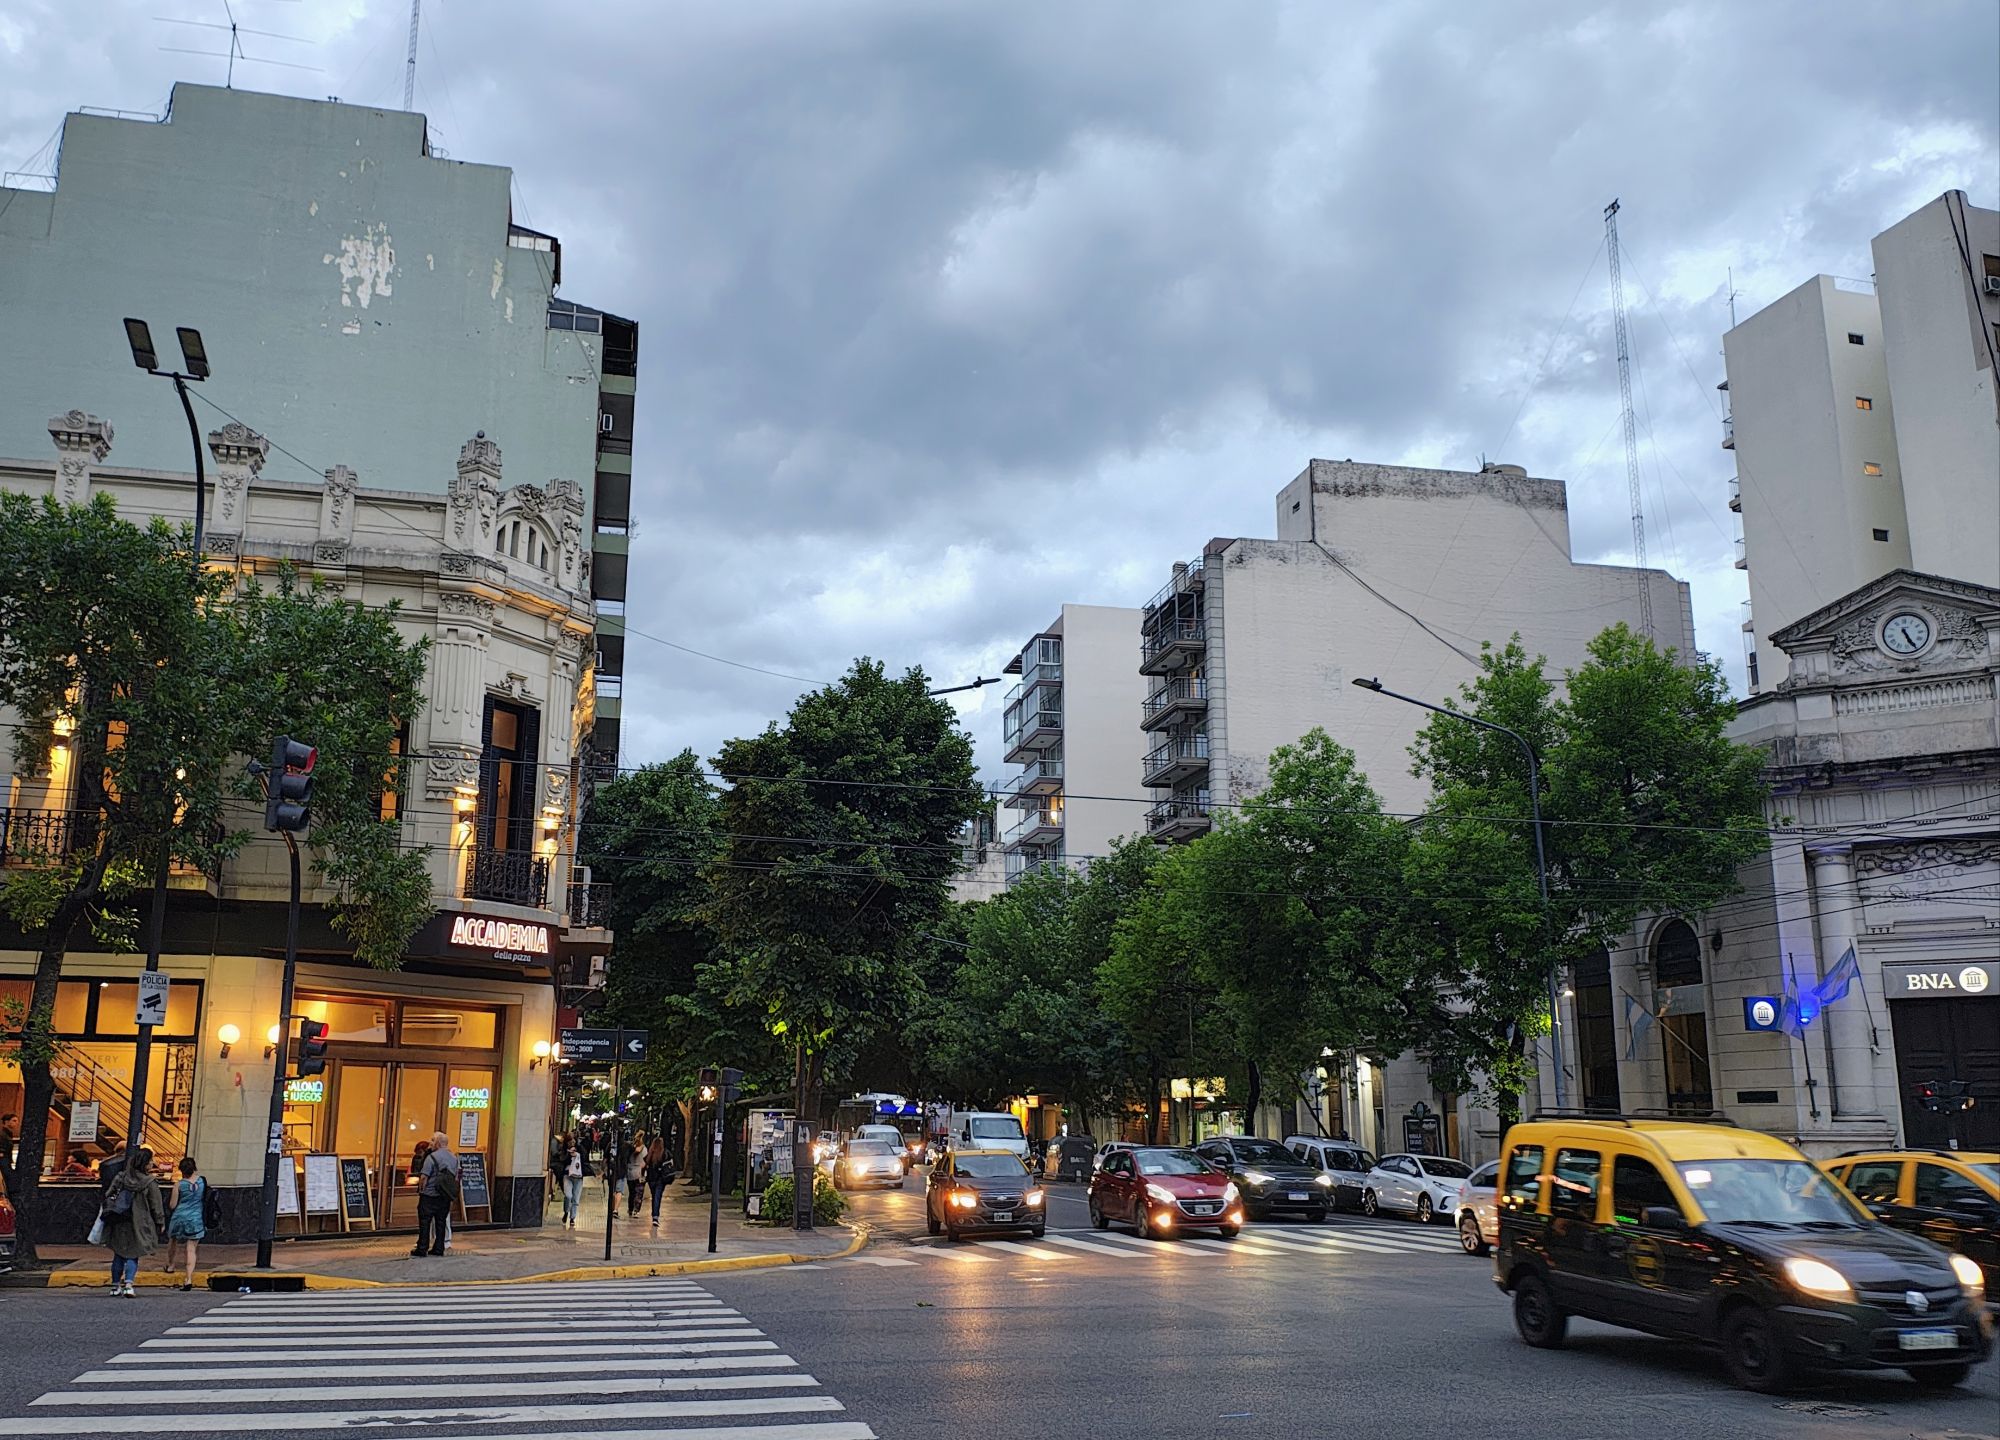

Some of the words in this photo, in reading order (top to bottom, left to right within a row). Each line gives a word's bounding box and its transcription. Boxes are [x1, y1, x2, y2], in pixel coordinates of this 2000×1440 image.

[1903, 867, 1964, 881] BANCO
[1938, 879, 1952, 887] LA
[451, 917, 548, 953] ACCADEMIA
[494, 951, 512, 960] della
[512, 954, 531, 962] pizza
[1906, 973, 1956, 990] BNA
[562, 1038, 610, 1046] Independencia
[290, 1091, 322, 1102] JUEGOS
[449, 1098, 461, 1108] DE
[461, 1098, 488, 1109] JUEGOS
